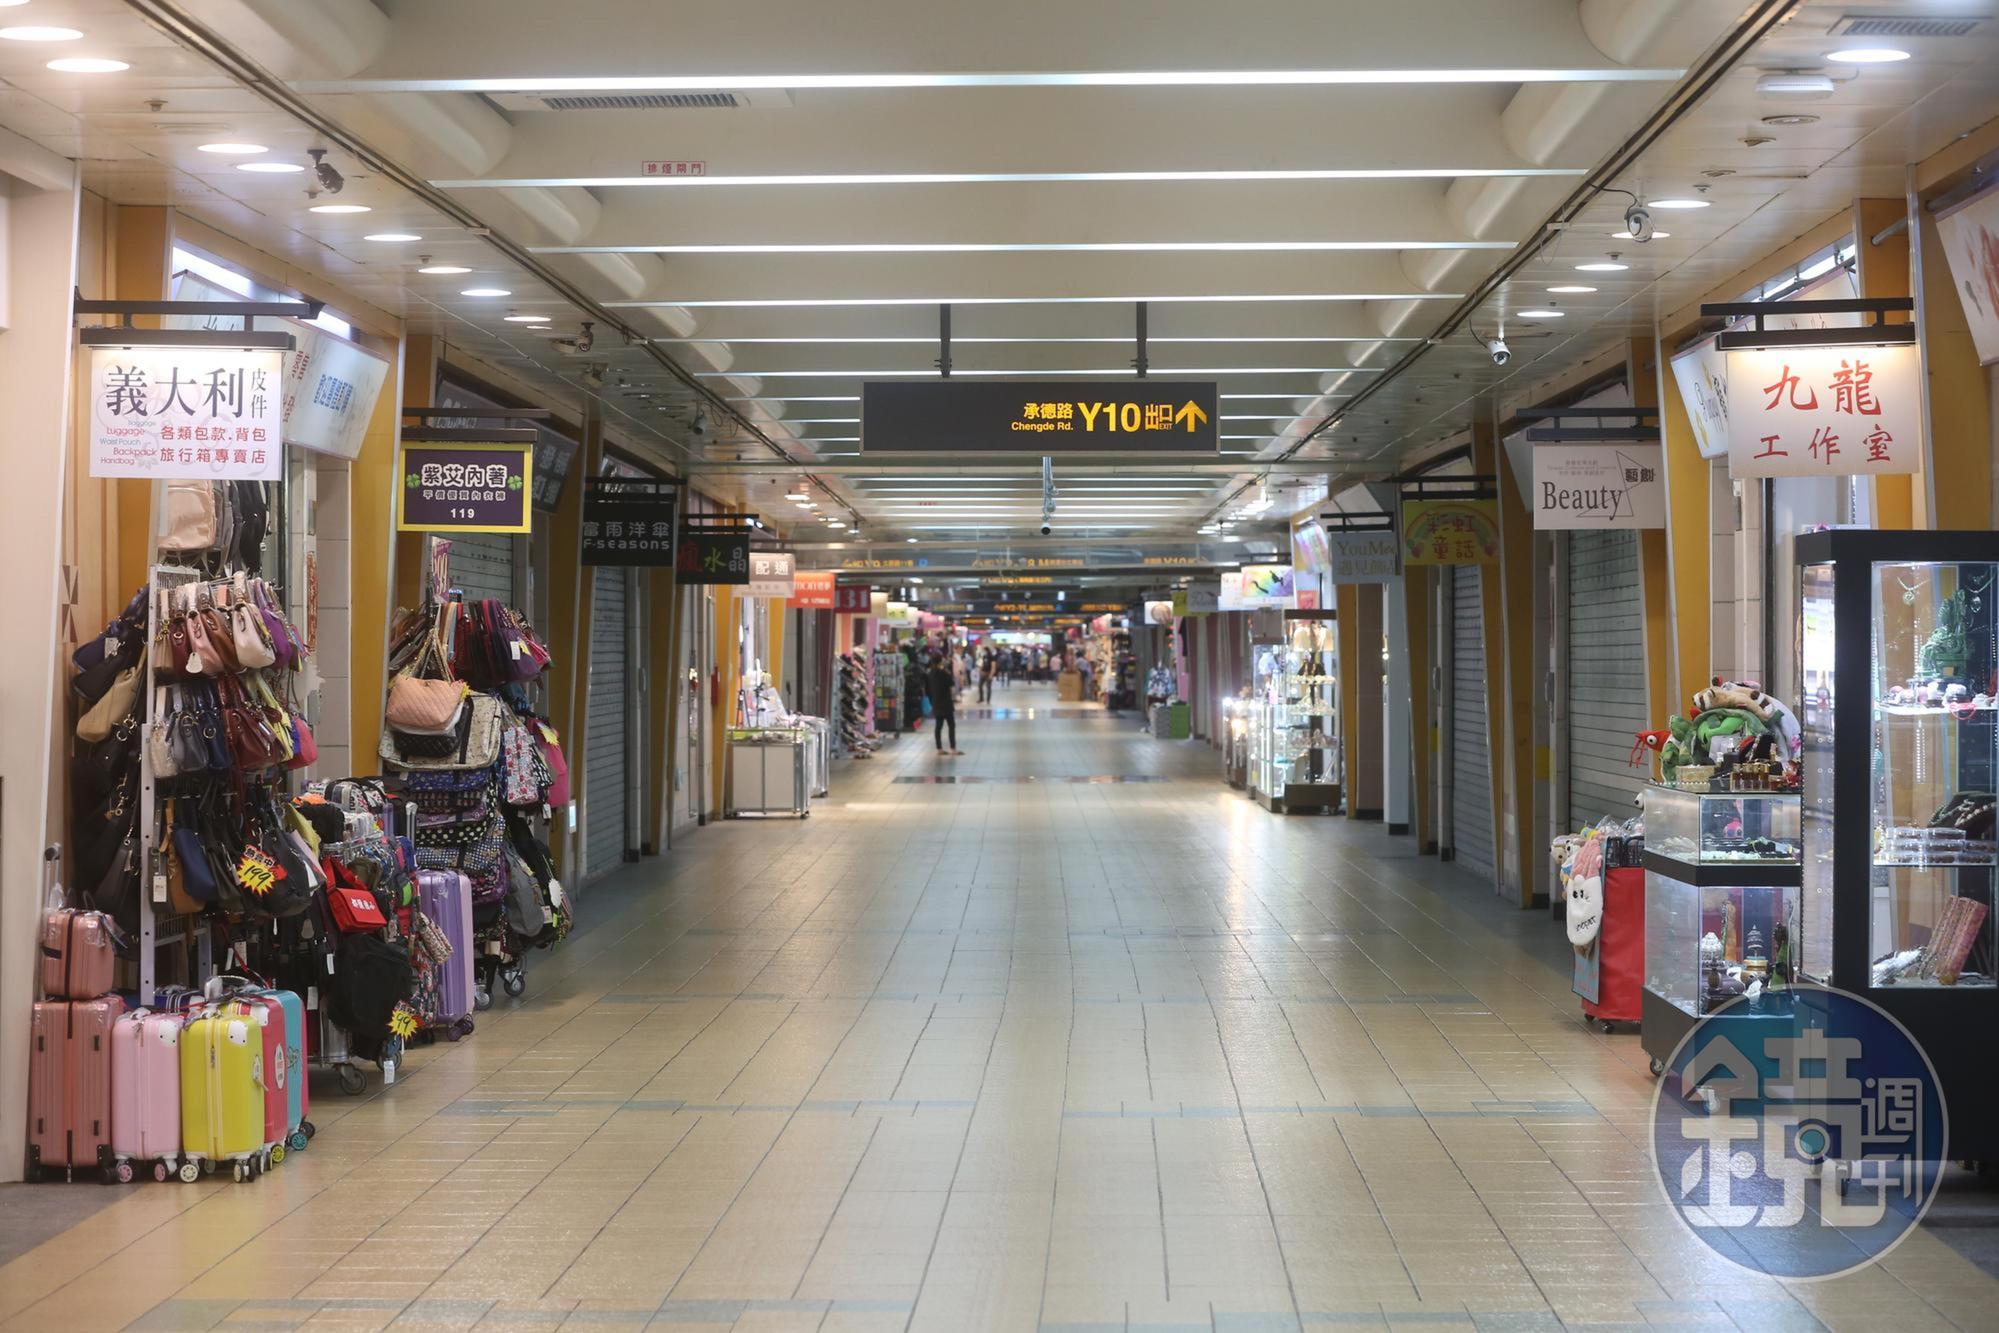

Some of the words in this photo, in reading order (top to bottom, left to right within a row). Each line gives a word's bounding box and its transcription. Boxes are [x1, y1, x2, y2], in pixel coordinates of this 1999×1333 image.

[105, 365, 244, 418] 義大利
[250, 367, 268, 420] 皮件
[1763, 359, 1882, 416] 九龍
[1023, 402, 1073, 420] 承德路
[1077, 402, 1141, 433] Y10
[1144, 403, 1173, 431] 出口
[106, 427, 145, 437] Luggage
[160, 425, 267, 442] 各類包款.背包
[1011, 421, 1054, 433] Chengde
[1057, 421, 1074, 431] Rd.
[1159, 422, 1173, 430] EXIT
[113, 447, 157, 457] Backpack
[1753, 424, 1894, 465] 工作室
[100, 457, 135, 465] Handbag
[160, 447, 267, 464] 旅行箱專賣店
[1542, 481, 1623, 521] Beauty
[450, 508, 475, 519] 119
[1426, 512, 1475, 534] 彩虹
[583, 521, 670, 538] 富雨洋傘
[1431, 535, 1475, 560] 童話
[243, 865, 272, 888] 199
[396, 1013, 411, 1032] 99
